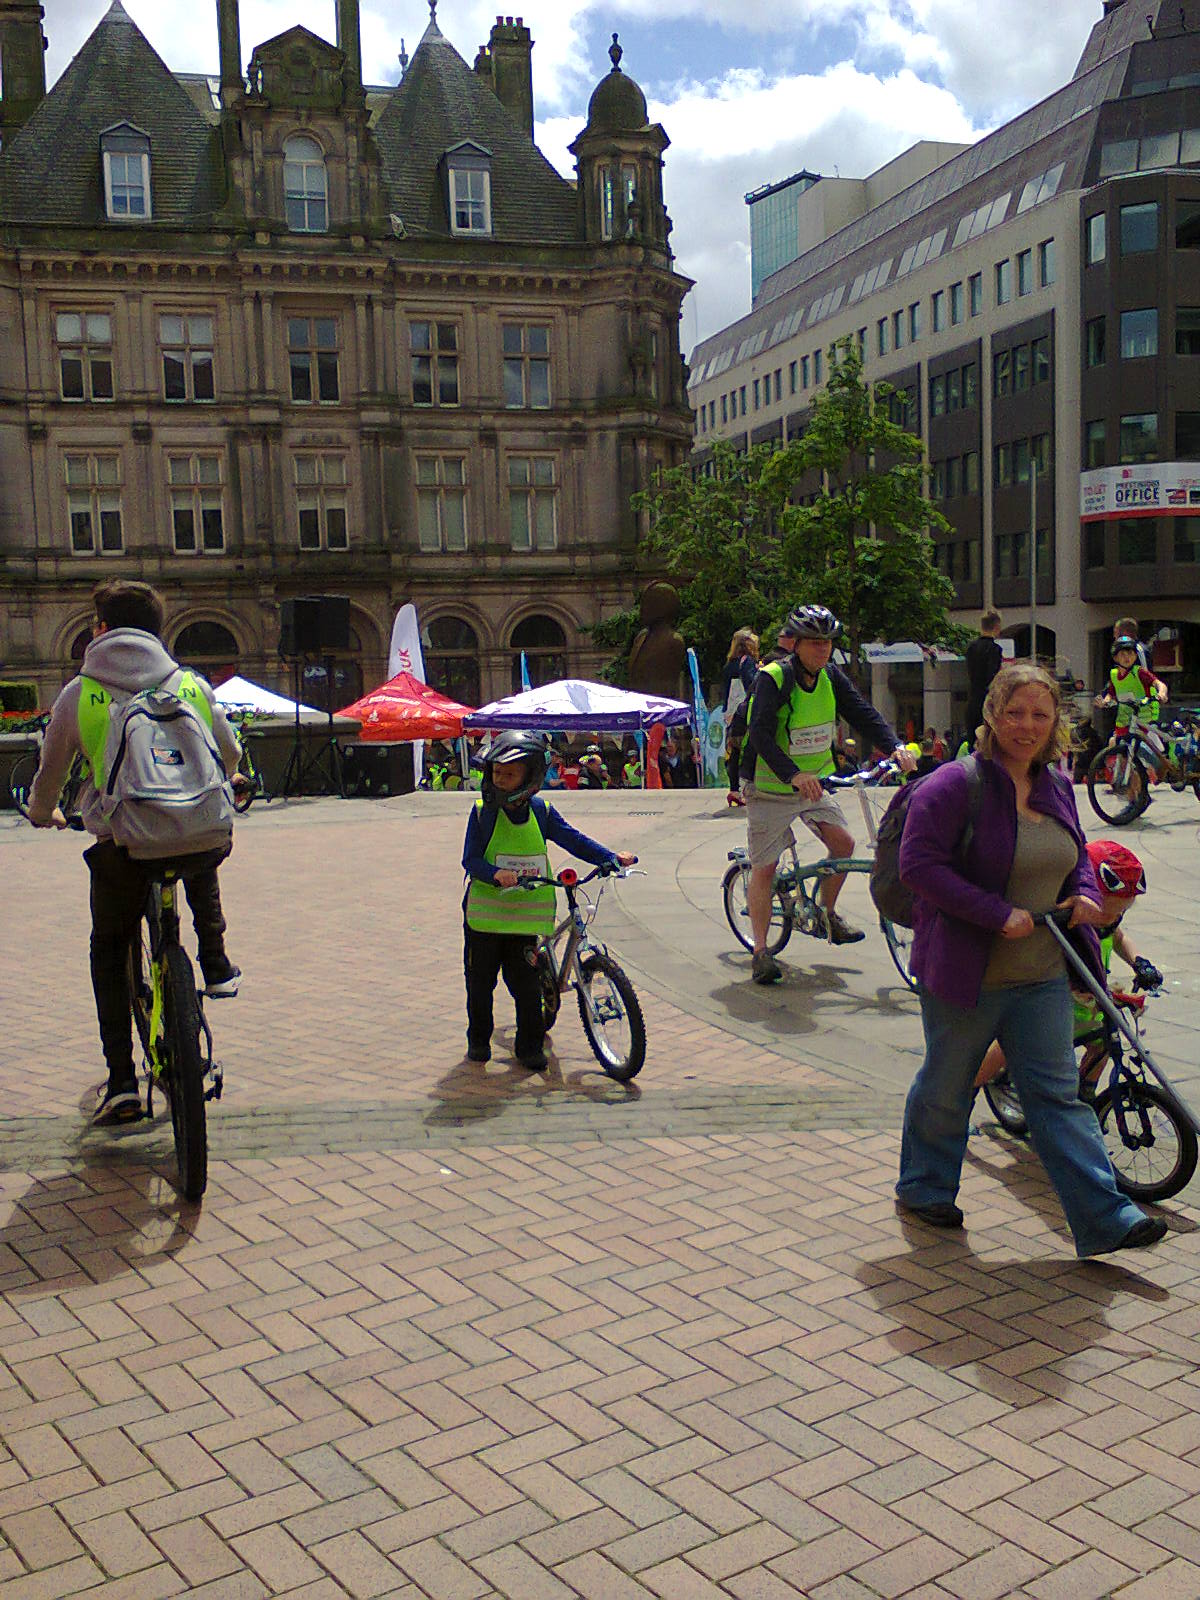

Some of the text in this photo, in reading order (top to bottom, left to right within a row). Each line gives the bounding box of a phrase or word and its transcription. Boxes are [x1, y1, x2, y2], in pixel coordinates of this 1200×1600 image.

[1115, 488, 1160, 502] OFFICE
[90, 692, 105, 706] N
[181, 687, 197, 698] N
